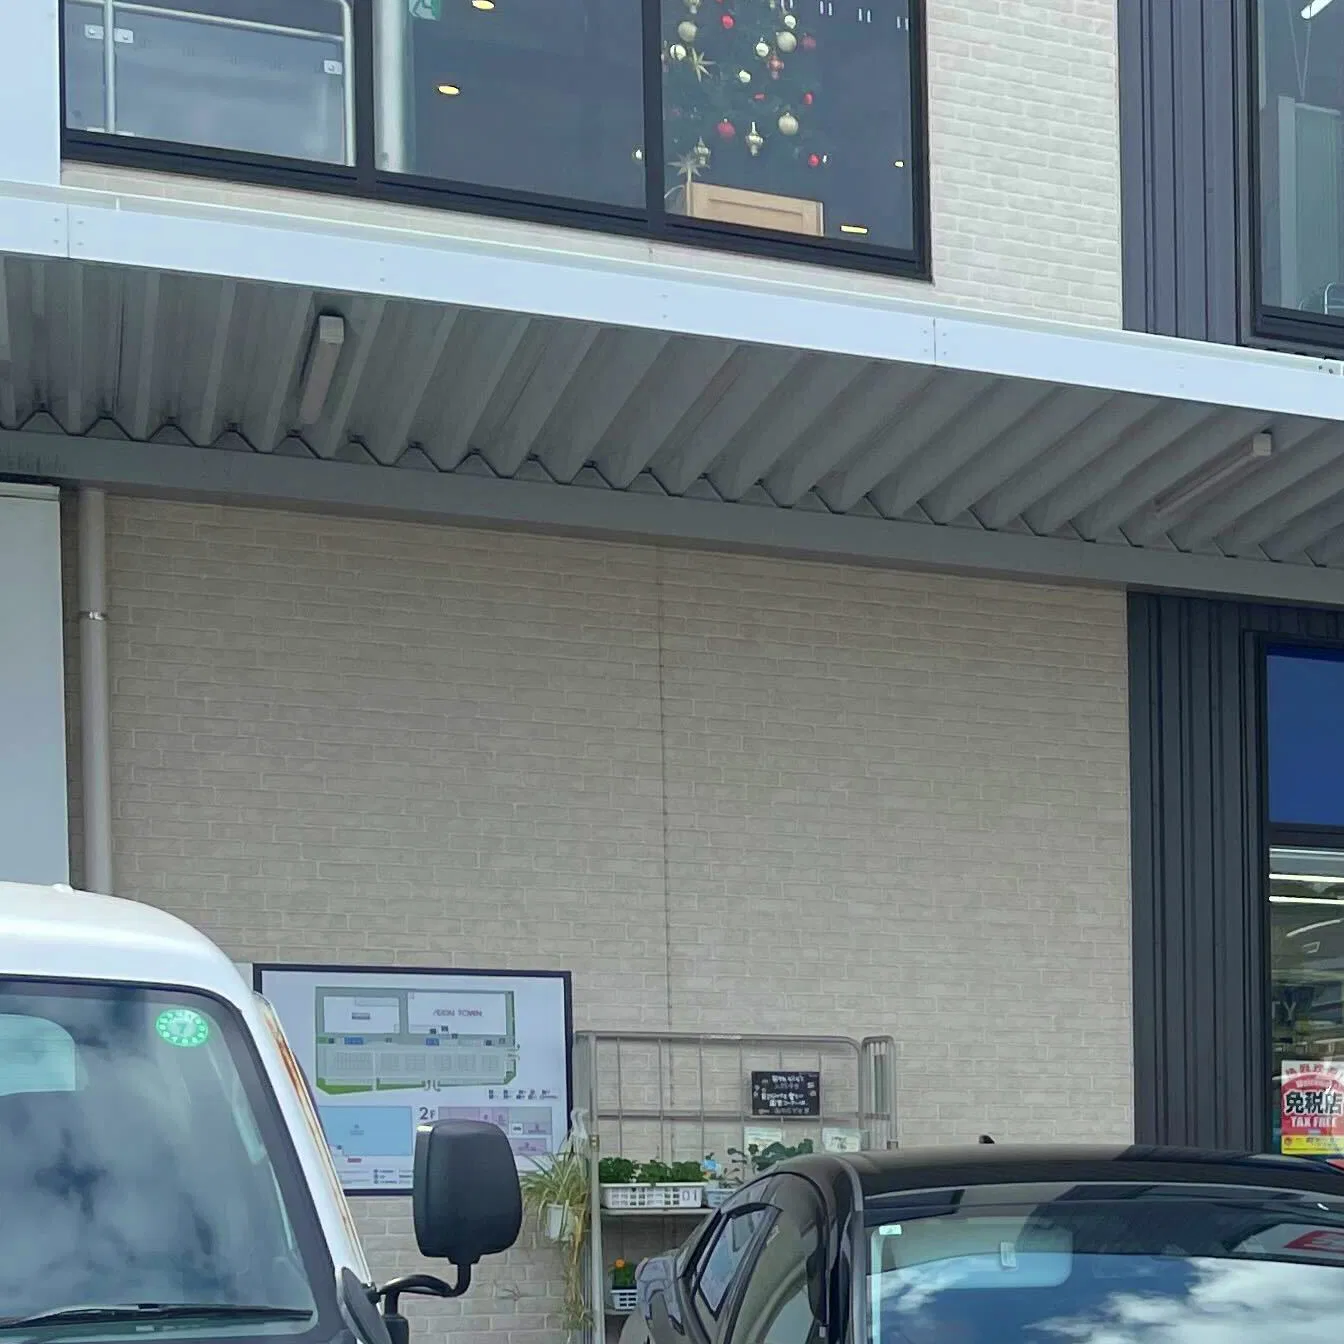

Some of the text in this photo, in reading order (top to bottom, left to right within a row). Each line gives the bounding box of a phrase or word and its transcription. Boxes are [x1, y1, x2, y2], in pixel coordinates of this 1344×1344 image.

[1286, 1091, 1343, 1114] 免税店
[1291, 1116, 1312, 1128] TAX
